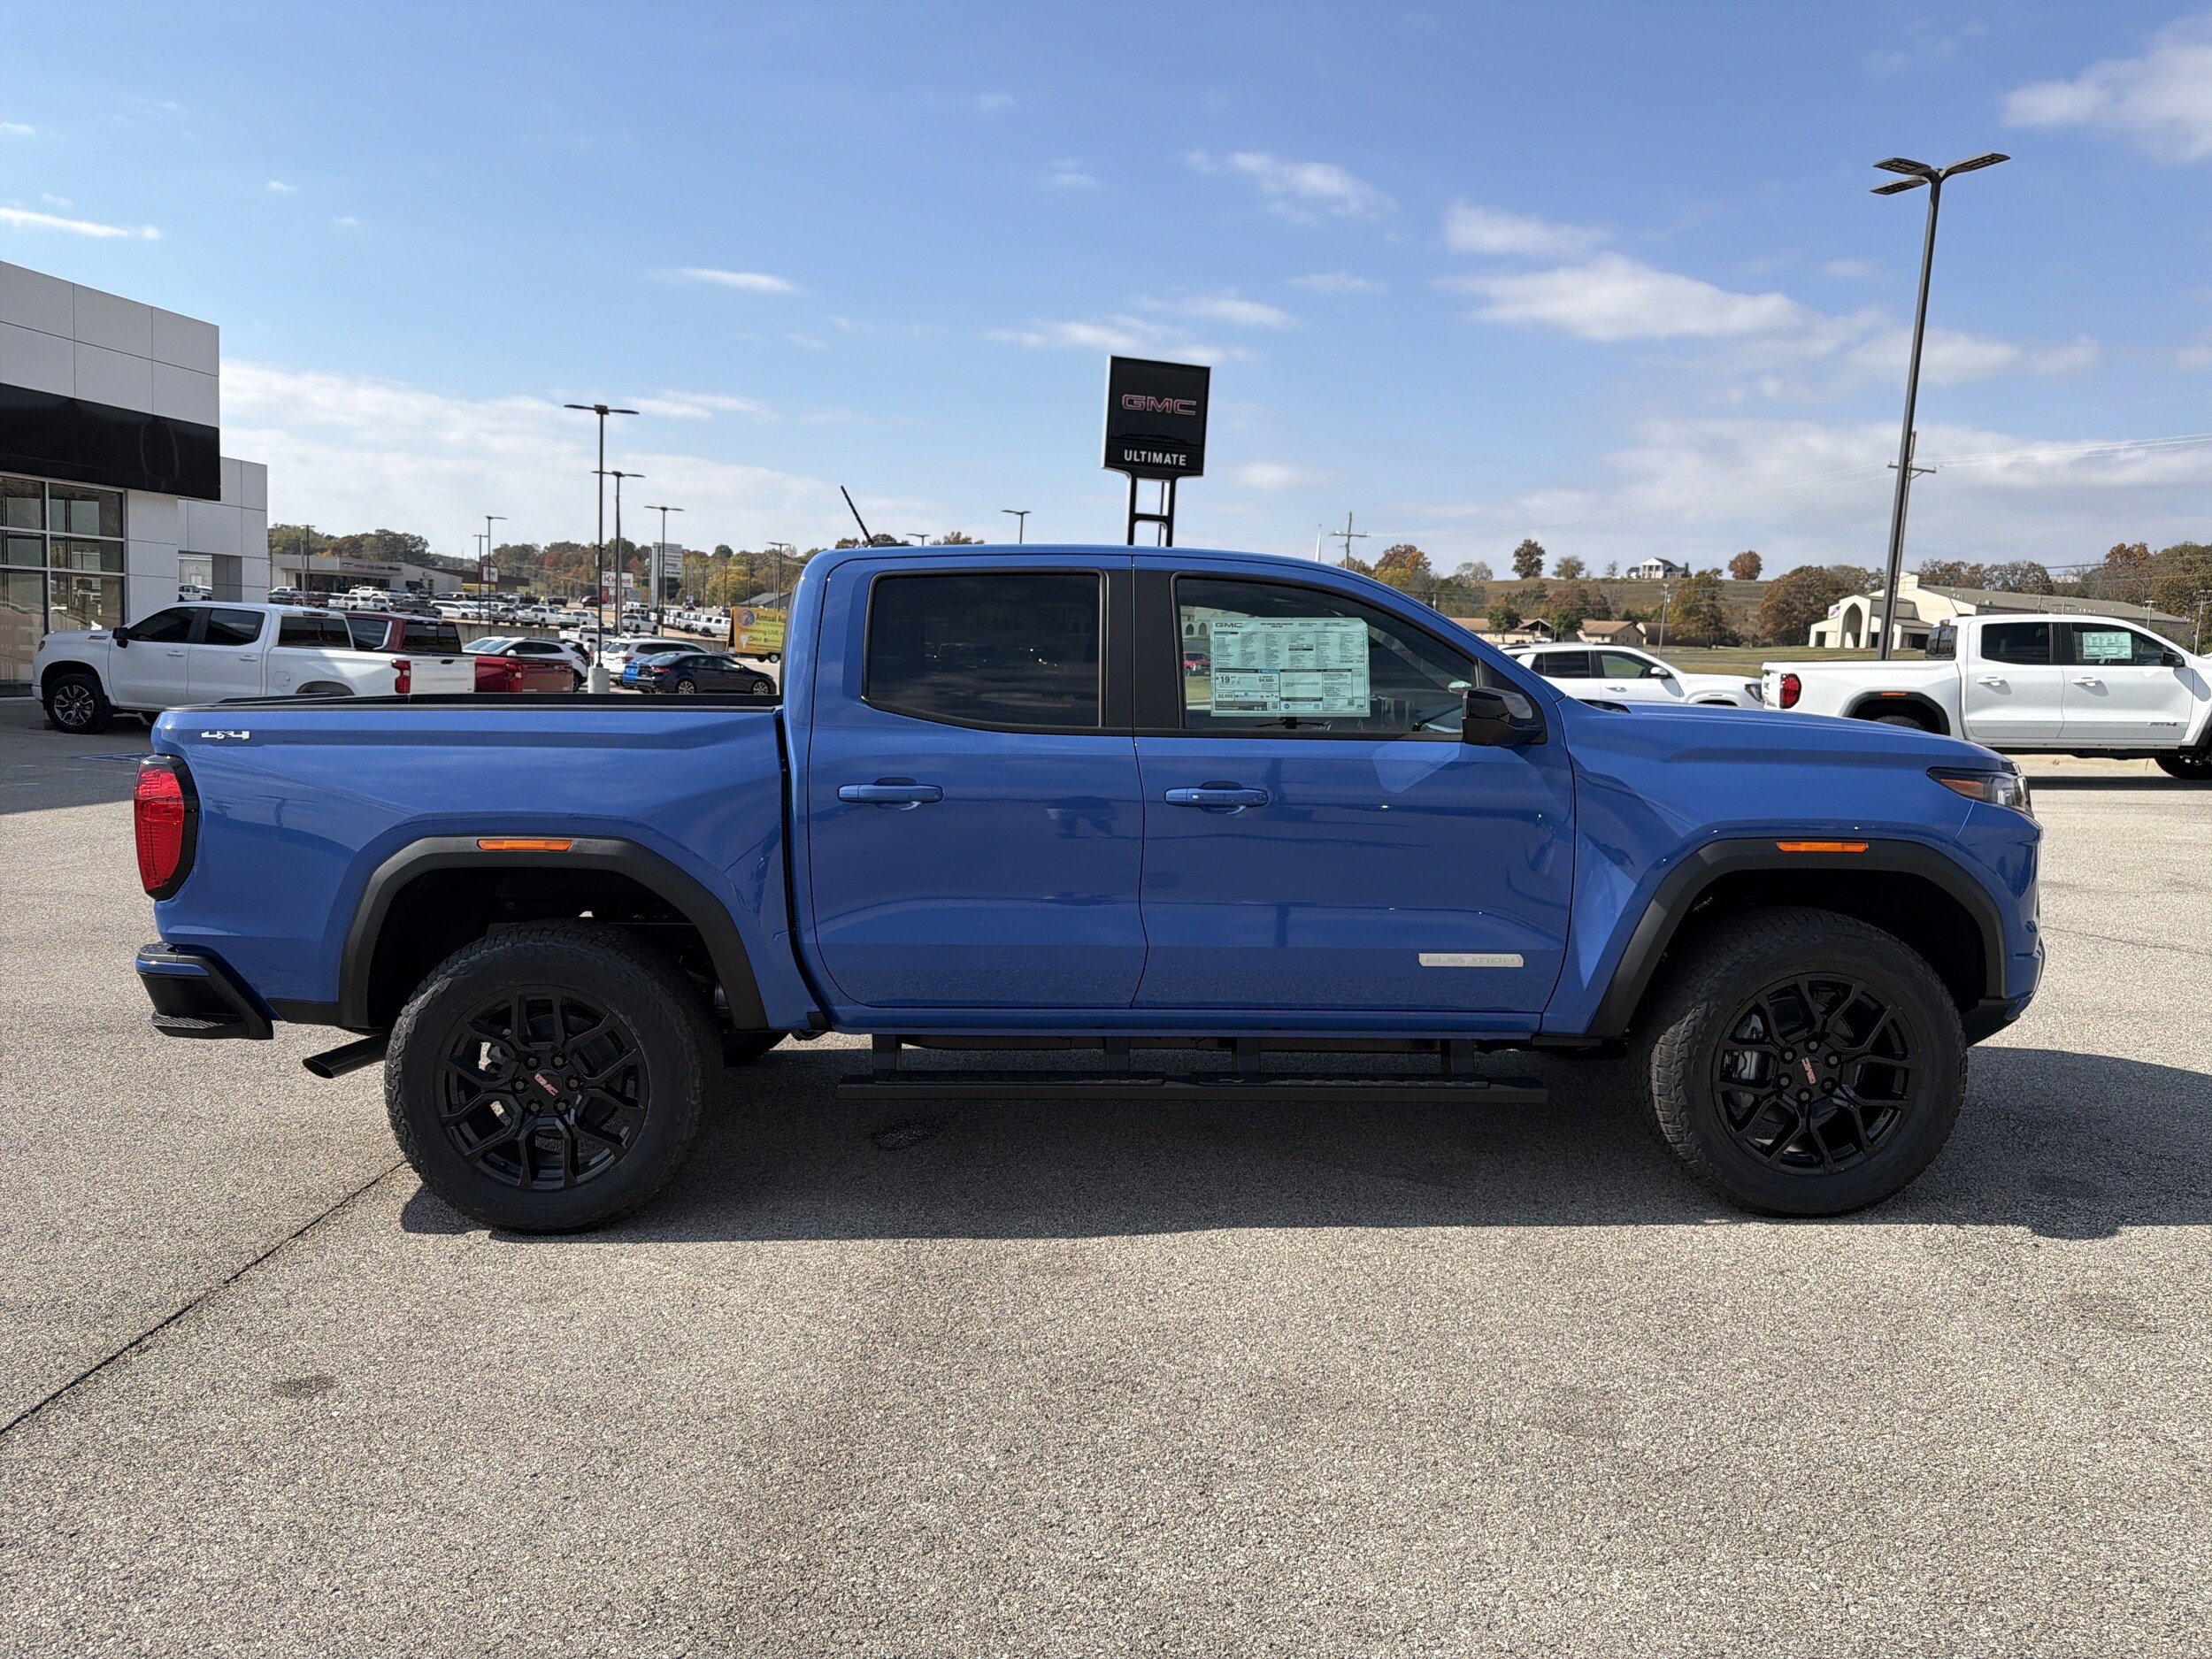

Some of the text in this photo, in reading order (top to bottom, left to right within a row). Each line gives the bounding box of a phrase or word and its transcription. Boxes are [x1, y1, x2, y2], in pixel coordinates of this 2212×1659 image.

[1122, 394, 1197, 416] GMC
[1124, 449, 1187, 466] ULTIMATE
[756, 612, 777, 622] Annual
